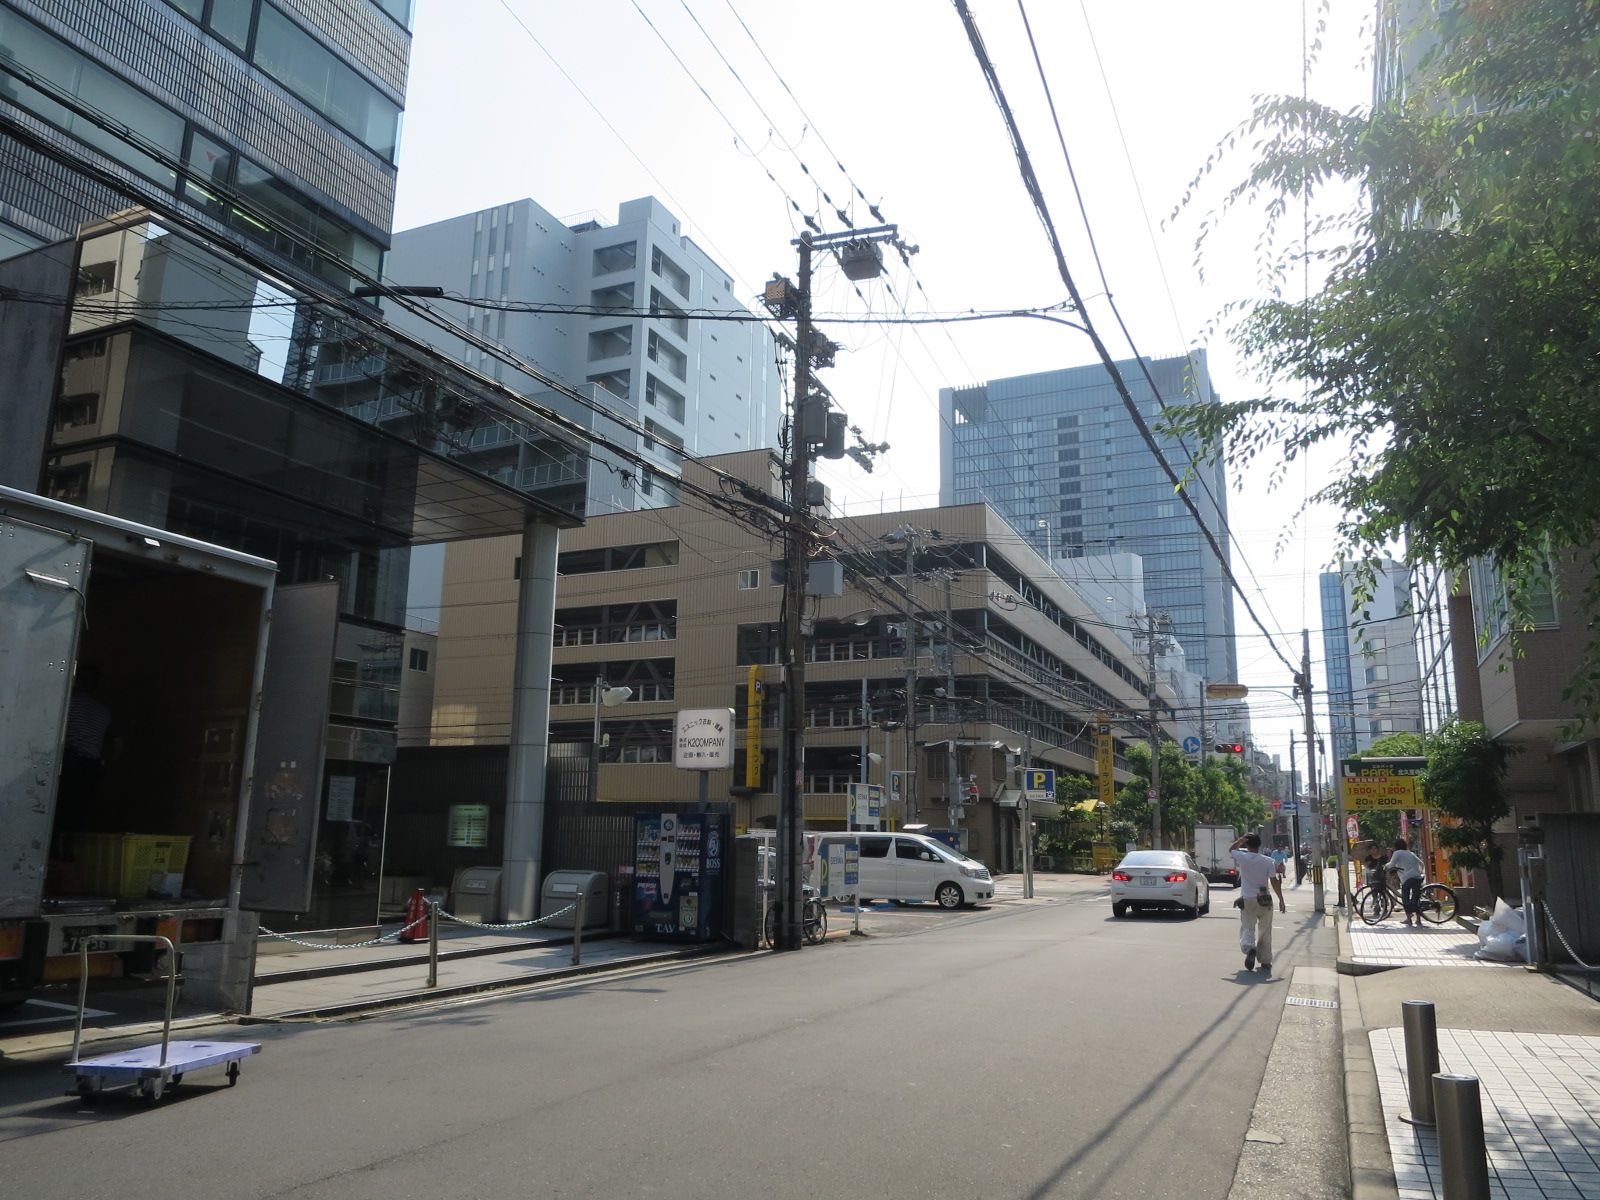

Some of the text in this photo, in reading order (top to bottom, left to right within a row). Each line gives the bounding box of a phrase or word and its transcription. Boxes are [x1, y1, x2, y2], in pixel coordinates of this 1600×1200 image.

[688, 737, 725, 747] K2COMPANY
[1361, 768, 1394, 776] PARK
[1033, 772, 1046, 789] P
[706, 858, 720, 869] BOSS
